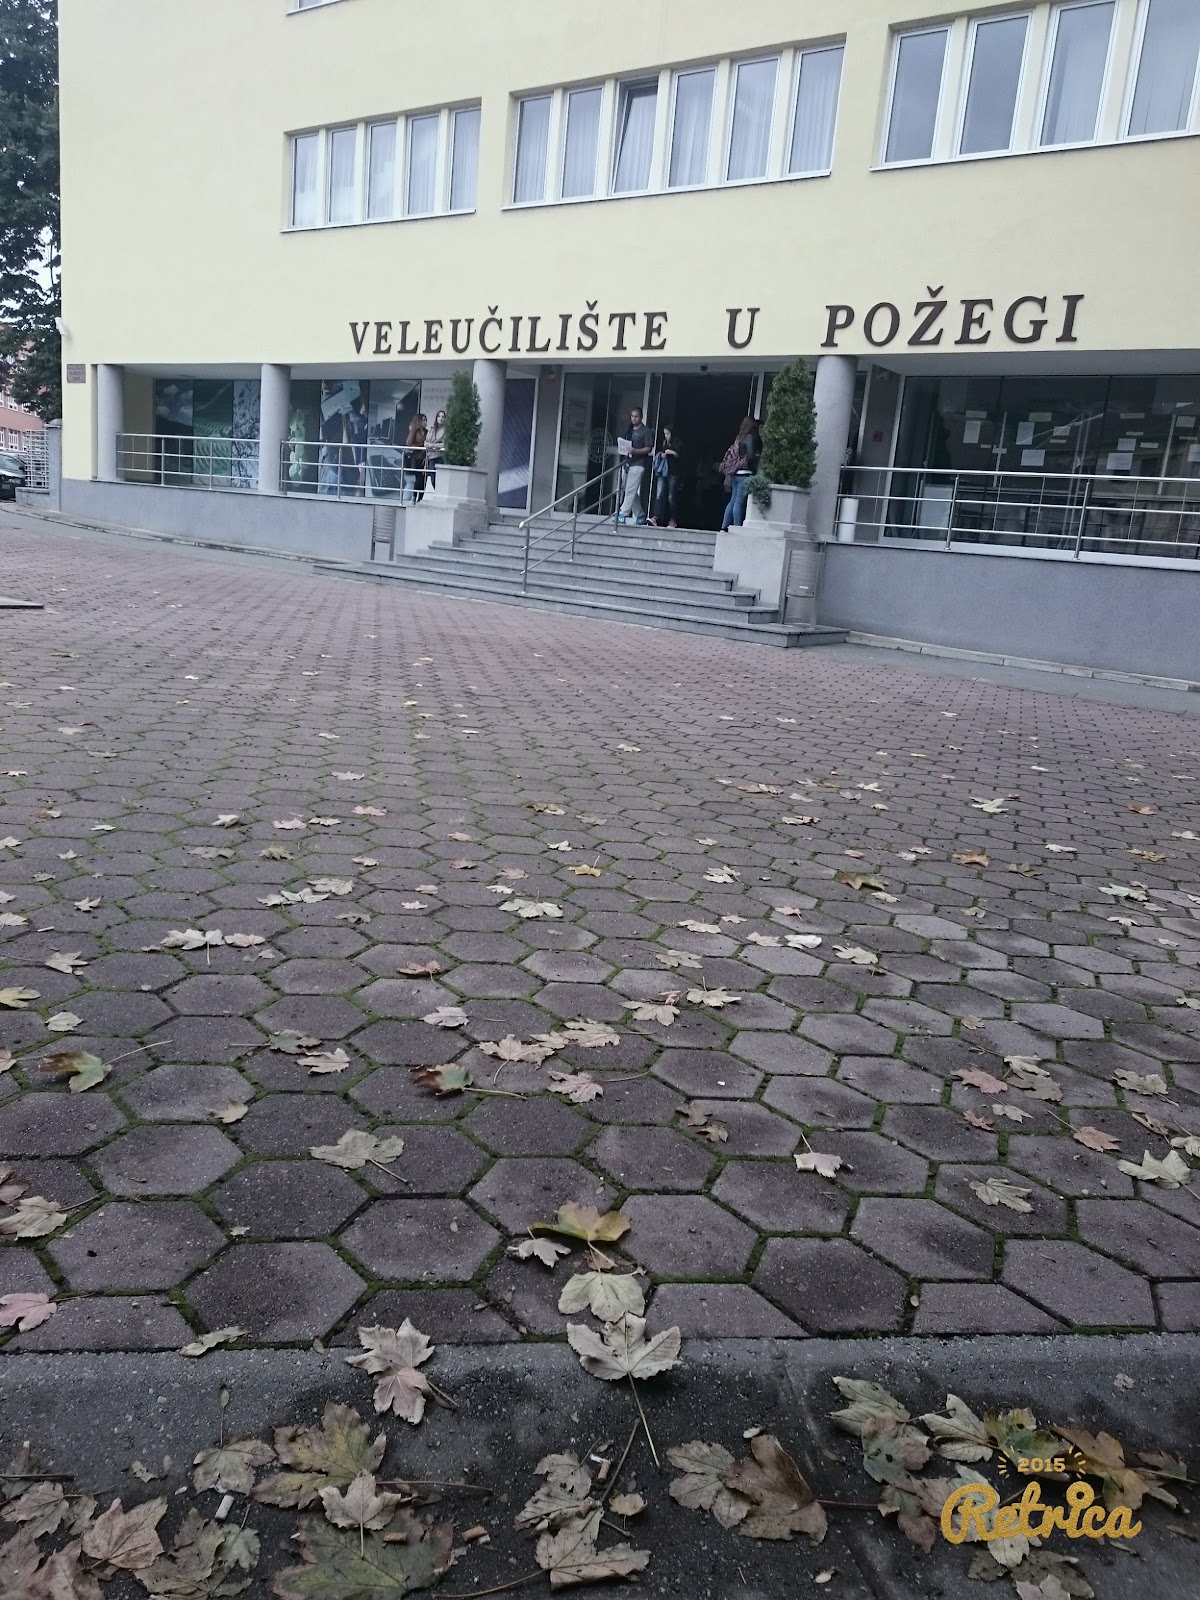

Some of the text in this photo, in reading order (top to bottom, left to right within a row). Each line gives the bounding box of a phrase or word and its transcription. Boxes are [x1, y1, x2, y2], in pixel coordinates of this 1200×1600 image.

[349, 285, 1084, 354] VELEUČILIŠTE U POŽEGI
